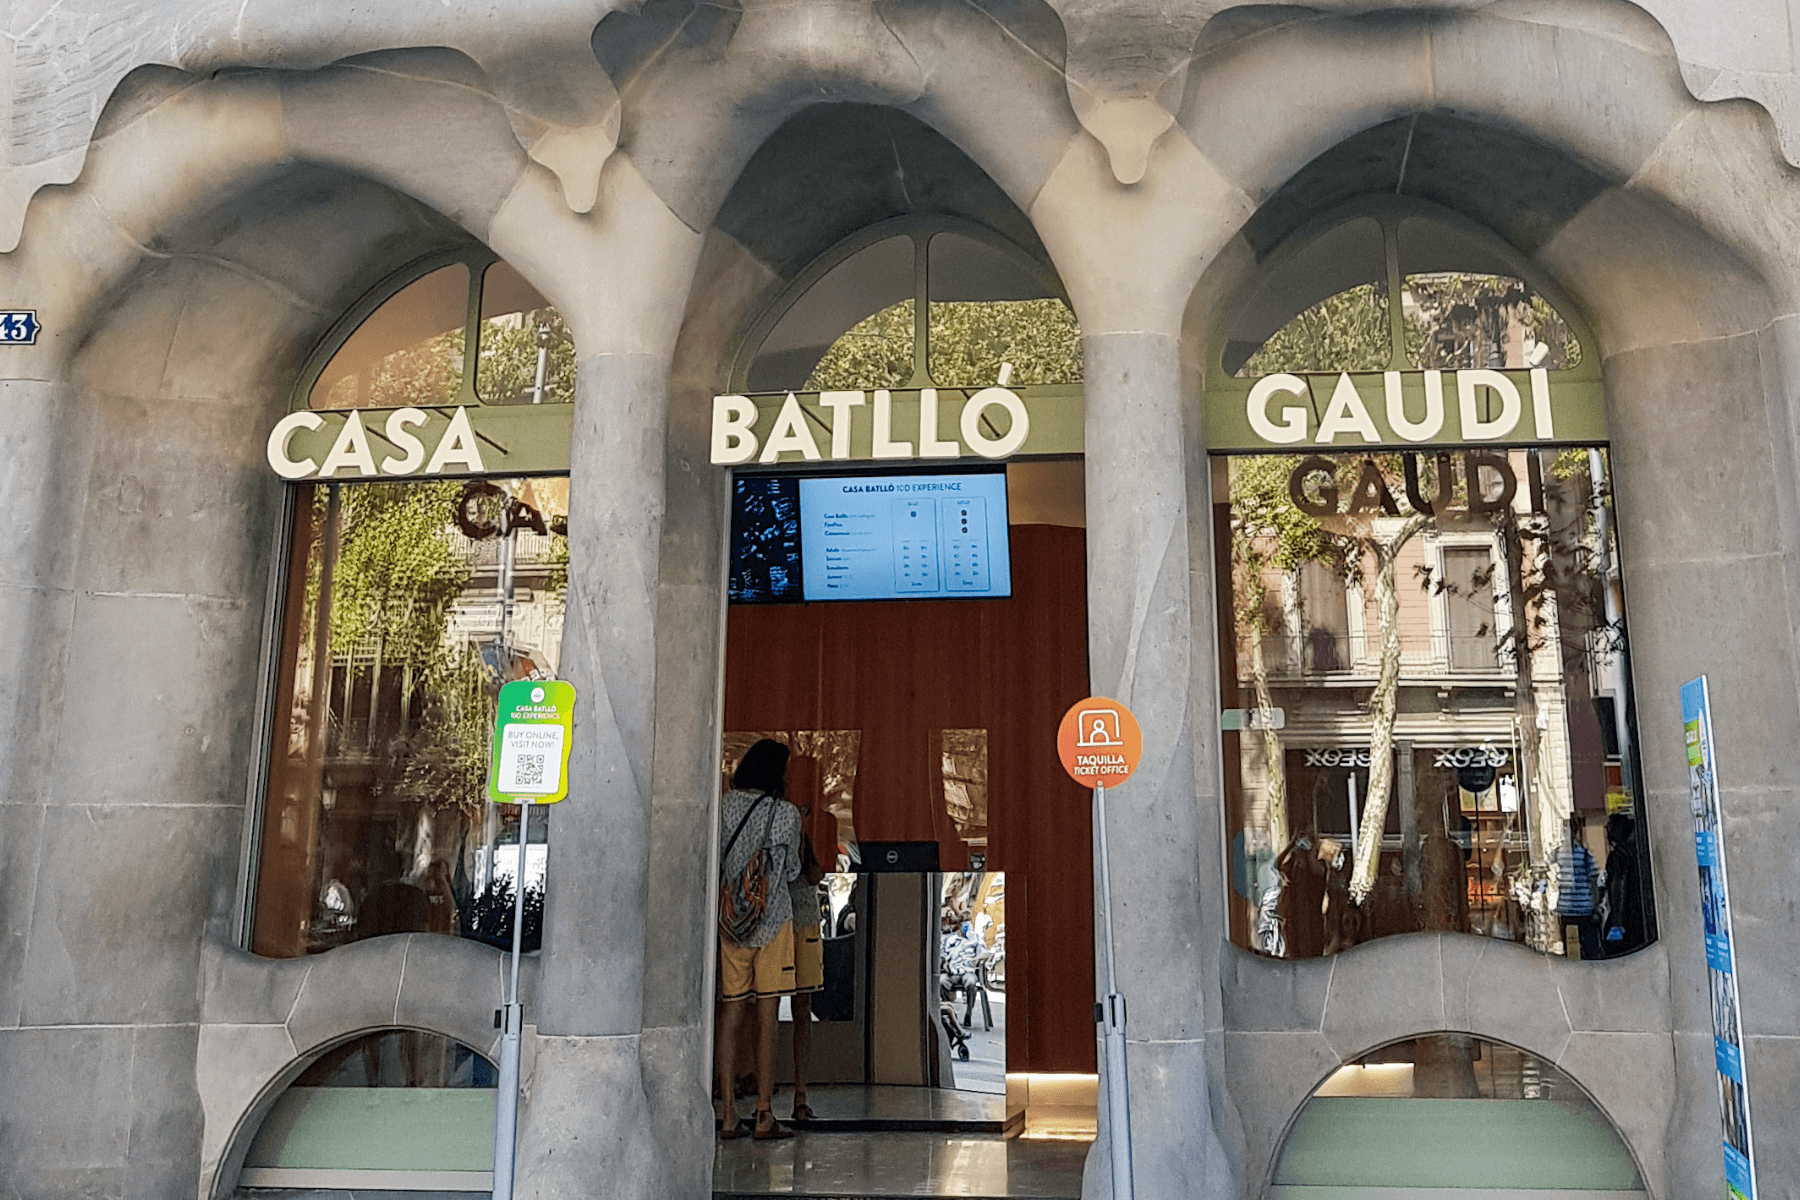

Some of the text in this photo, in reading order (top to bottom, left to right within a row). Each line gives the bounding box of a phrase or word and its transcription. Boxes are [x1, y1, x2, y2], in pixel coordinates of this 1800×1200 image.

[1246, 341, 1554, 444] GAUDÍ
[710, 362, 1031, 465] BATLLÓ
[267, 405, 487, 479] CASA
[842, 485, 864, 494] CASA
[912, 482, 963, 492] EXPERIENCE
[508, 731, 525, 739] BUY
[510, 740, 530, 748] VISIT
[1077, 755, 1124, 766] TAQUILLA
[1074, 765, 1129, 775] TICKET OFFICE
